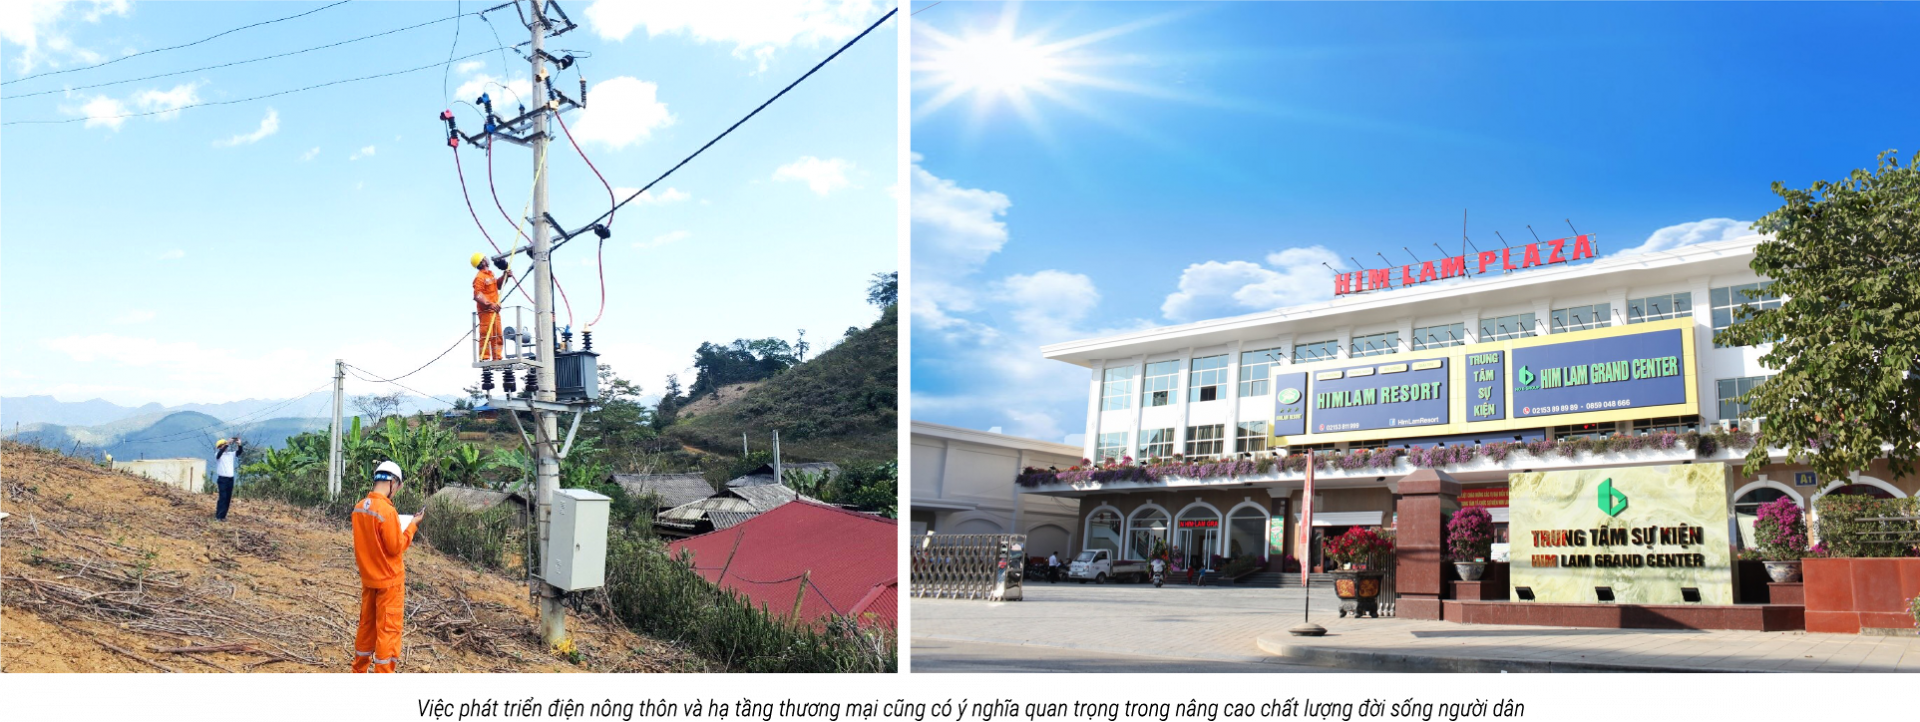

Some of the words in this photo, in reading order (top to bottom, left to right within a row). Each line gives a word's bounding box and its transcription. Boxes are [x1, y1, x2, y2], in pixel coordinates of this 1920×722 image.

[1334, 268, 1389, 296] HIM
[1402, 255, 1465, 285] LAM
[1478, 234, 1594, 274] PLAZA
[1469, 353, 1499, 366] TRUNG
[1474, 369, 1495, 383] TÂM
[1541, 368, 1562, 389] HIM
[1564, 364, 1589, 387] LAM
[1591, 360, 1630, 384] GRAND
[1632, 355, 1679, 380] CENTER
[1317, 388, 1376, 409] HIMLAM
[1381, 381, 1442, 404] RESORT
[1478, 386, 1492, 401] SỰ
[1474, 402, 1495, 418] KIỆN
[1532, 406, 1551, 414] 02153
[1560, 404, 1569, 412] 89
[1569, 403, 1578, 411] 89
[1586, 401, 1602, 409] 0859
[1603, 400, 1616, 408] 048
[1800, 474, 1812, 484] A1
[1531, 528, 1586, 547] TRUNG
[1589, 525, 1628, 546] TÂM
[1632, 525, 1658, 549] SỰ
[1660, 523, 1704, 549] KIỆN
[1531, 554, 1558, 568] HIM
[1561, 554, 1592, 568] LAM
[1595, 553, 1643, 568] GRAND
[1647, 553, 1705, 568] CENTER
